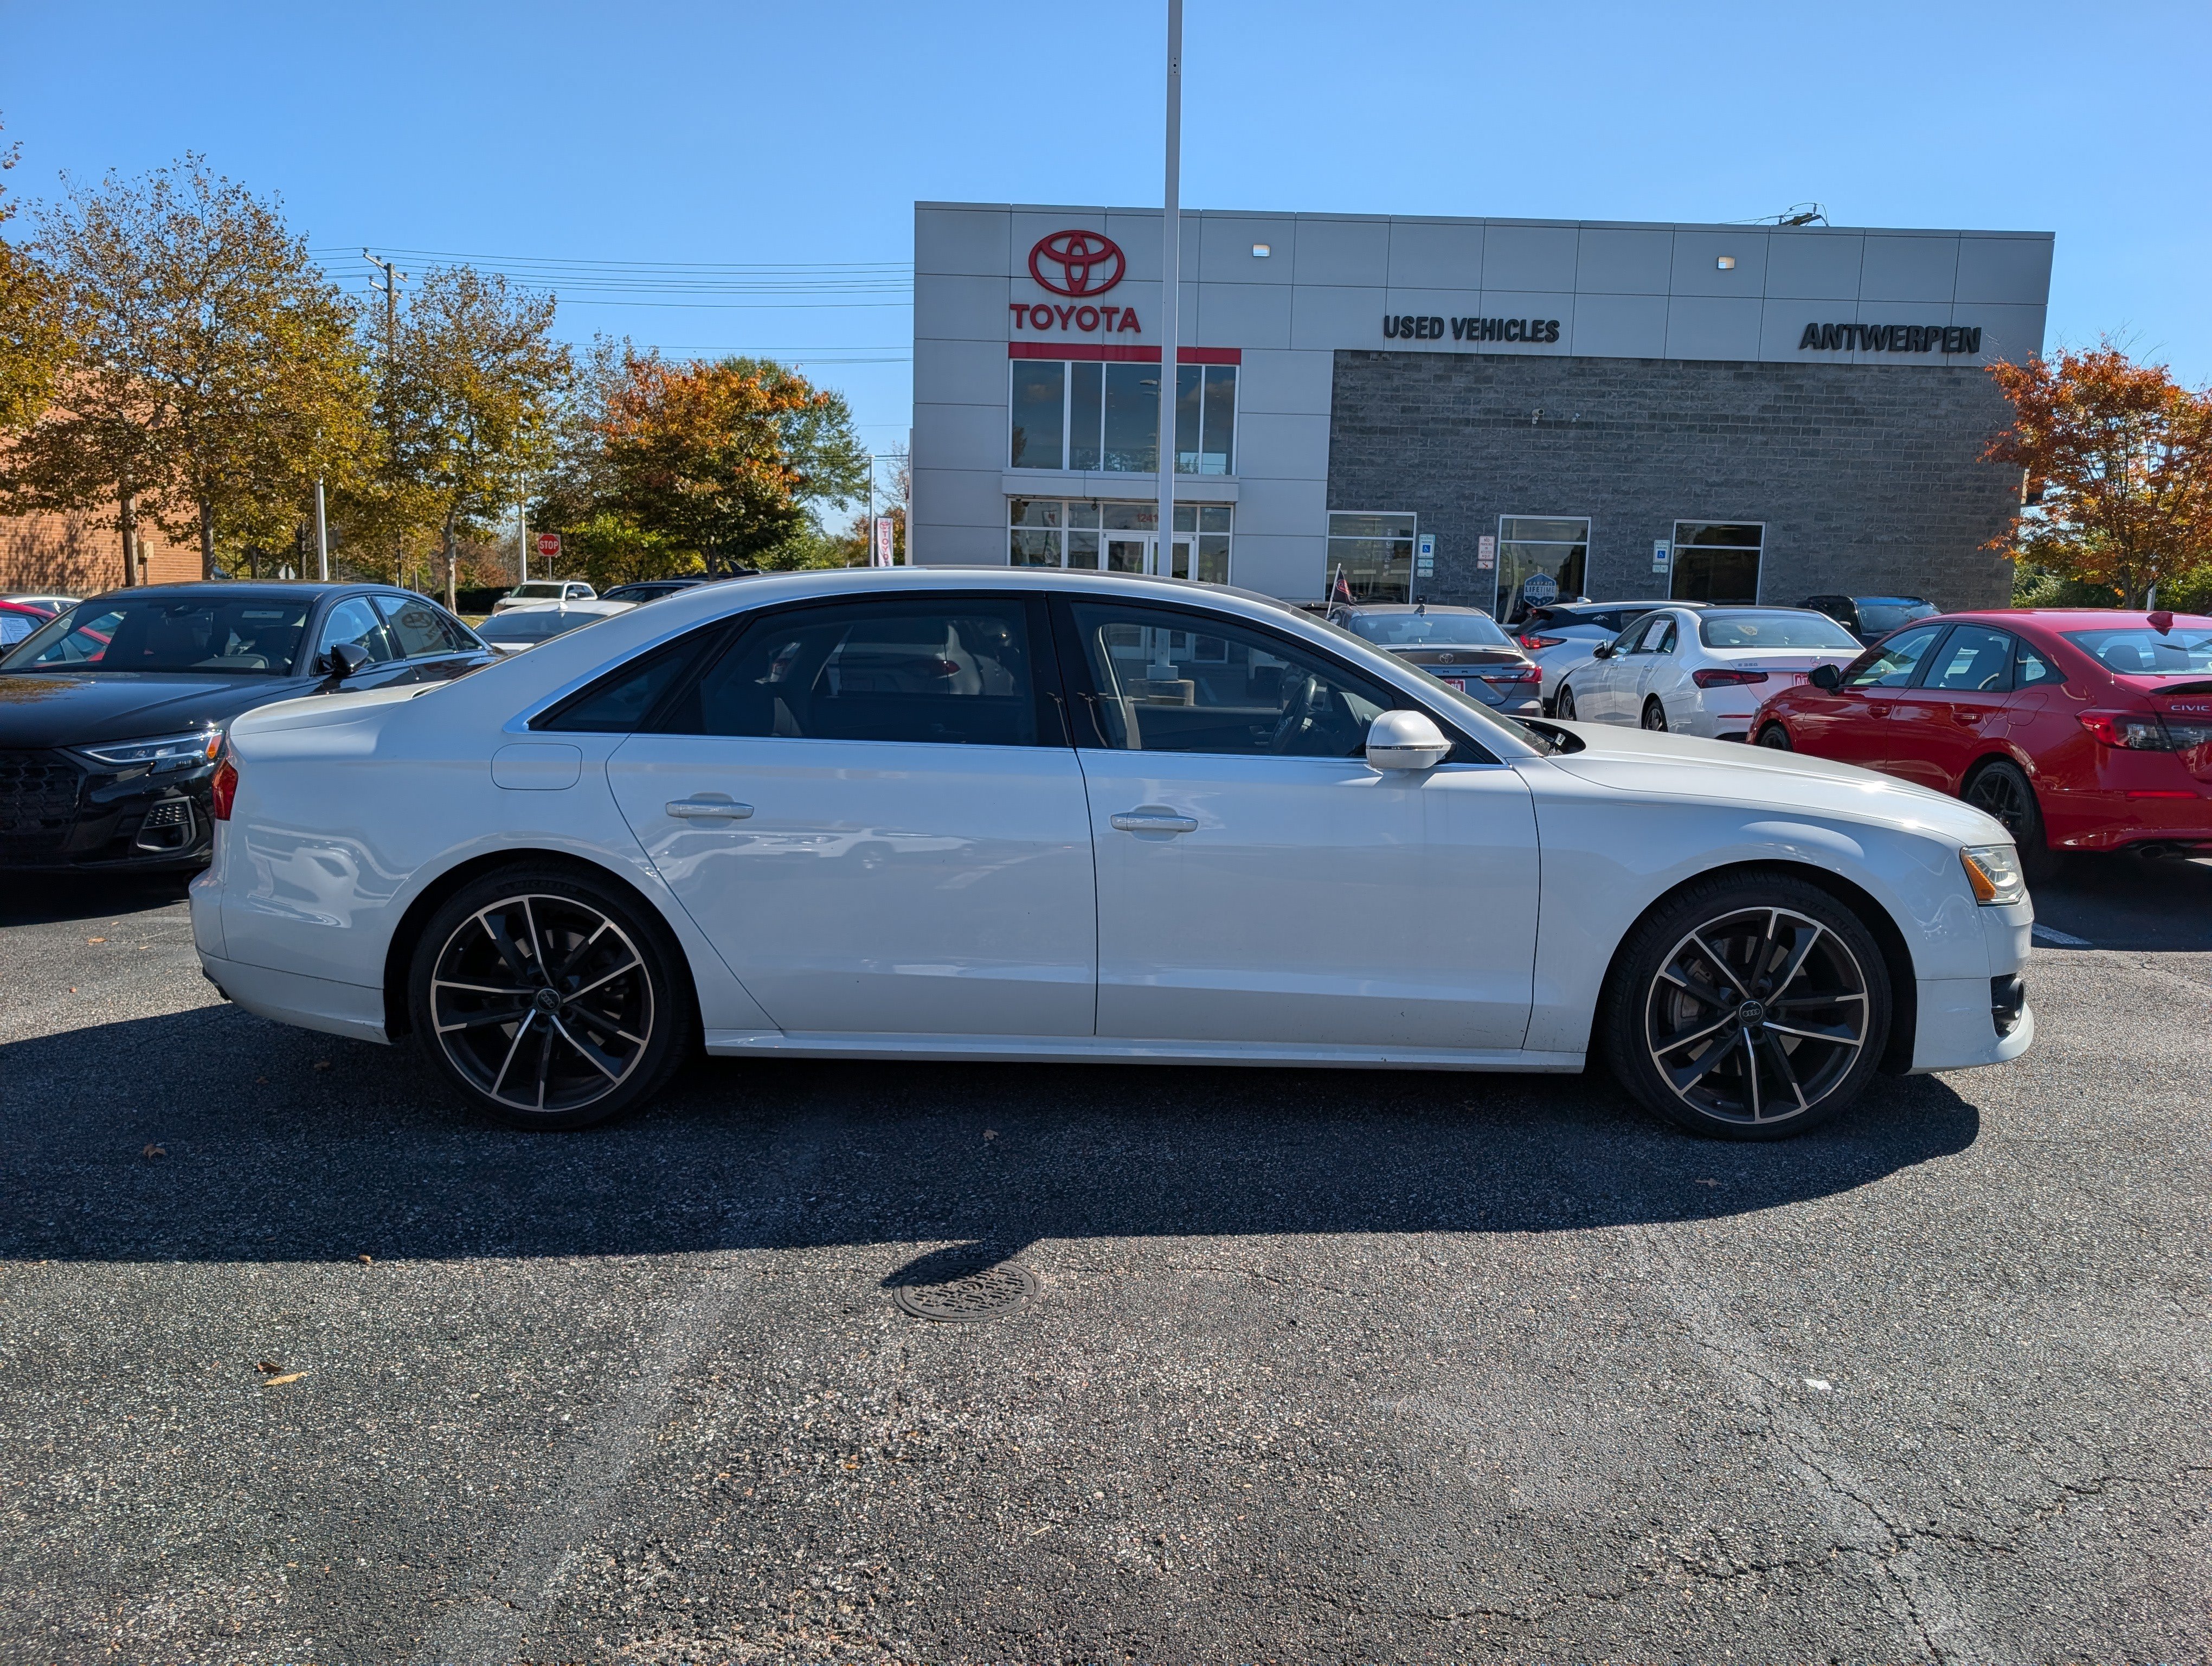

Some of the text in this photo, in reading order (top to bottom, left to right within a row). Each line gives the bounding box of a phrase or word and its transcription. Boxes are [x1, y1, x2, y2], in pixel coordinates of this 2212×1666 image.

[1009, 304, 1141, 332] TOYOTA
[1384, 315, 1560, 343] USED VEHICLES
[1799, 323, 1982, 353] ANTWERPEN
[539, 540, 558, 549] STOP
